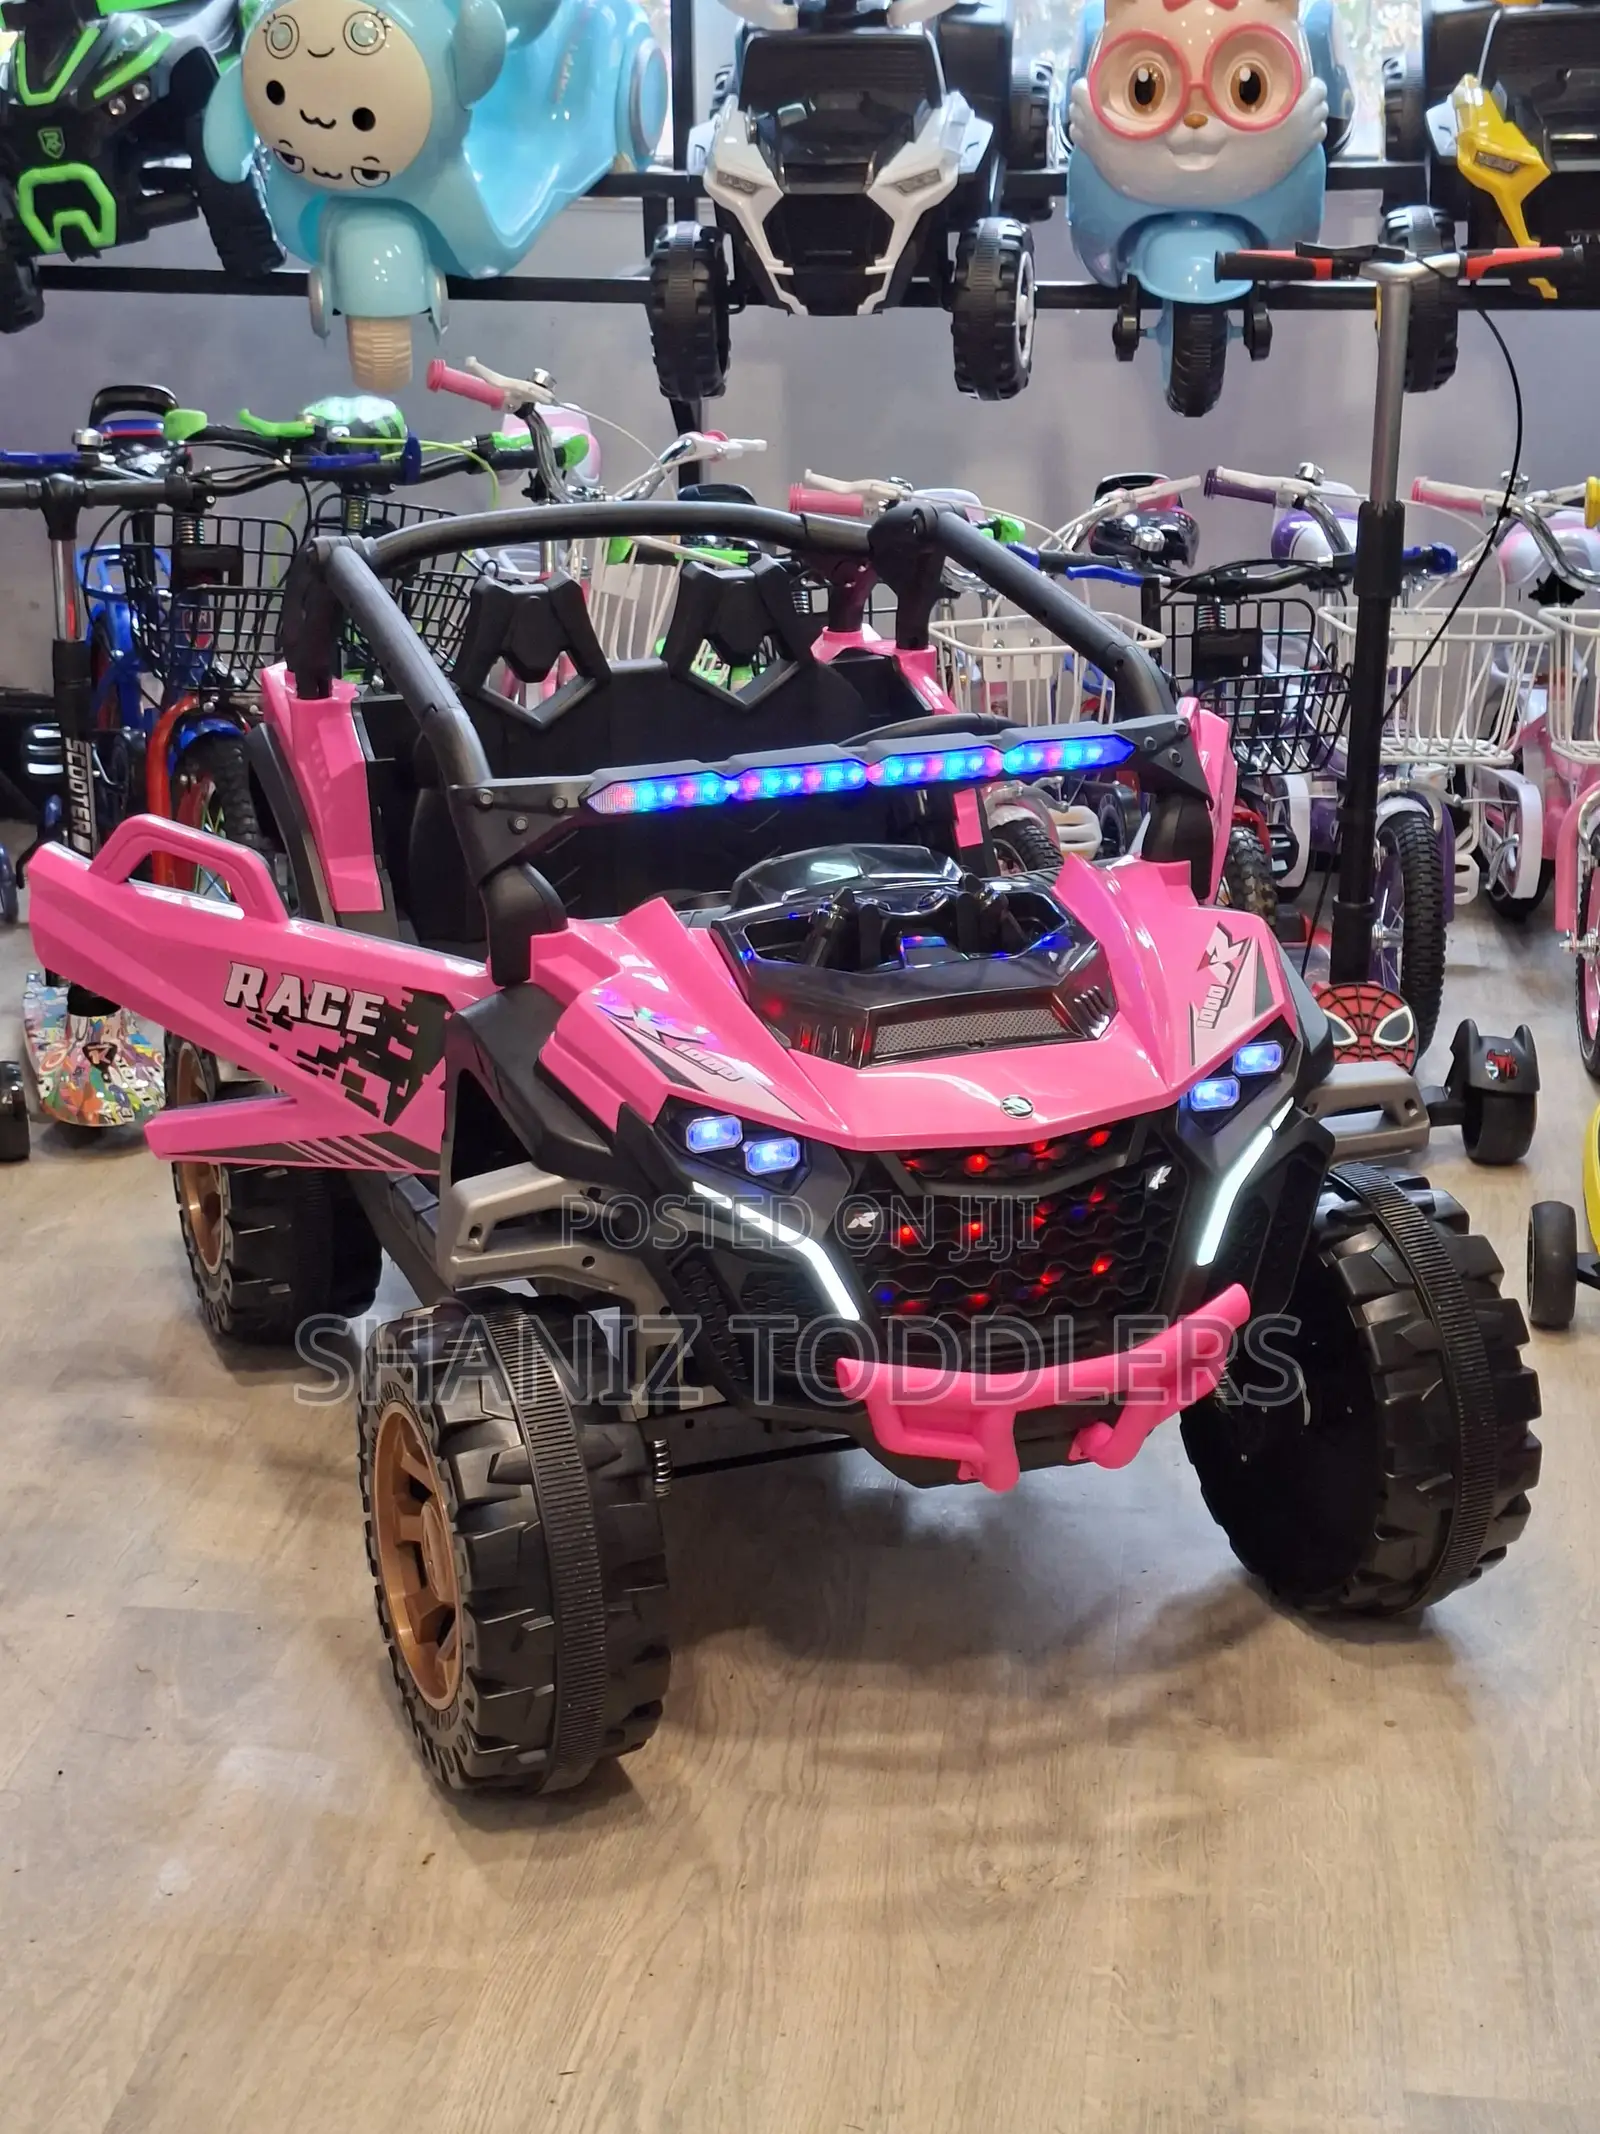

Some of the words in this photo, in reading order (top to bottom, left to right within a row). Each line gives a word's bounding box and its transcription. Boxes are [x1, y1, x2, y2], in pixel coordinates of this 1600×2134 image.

[1571, 234, 1600, 244] UT
[65, 737, 91, 834] SCOOTER
[223, 961, 386, 1036] RACE
[1196, 984, 1228, 1029] 1000
